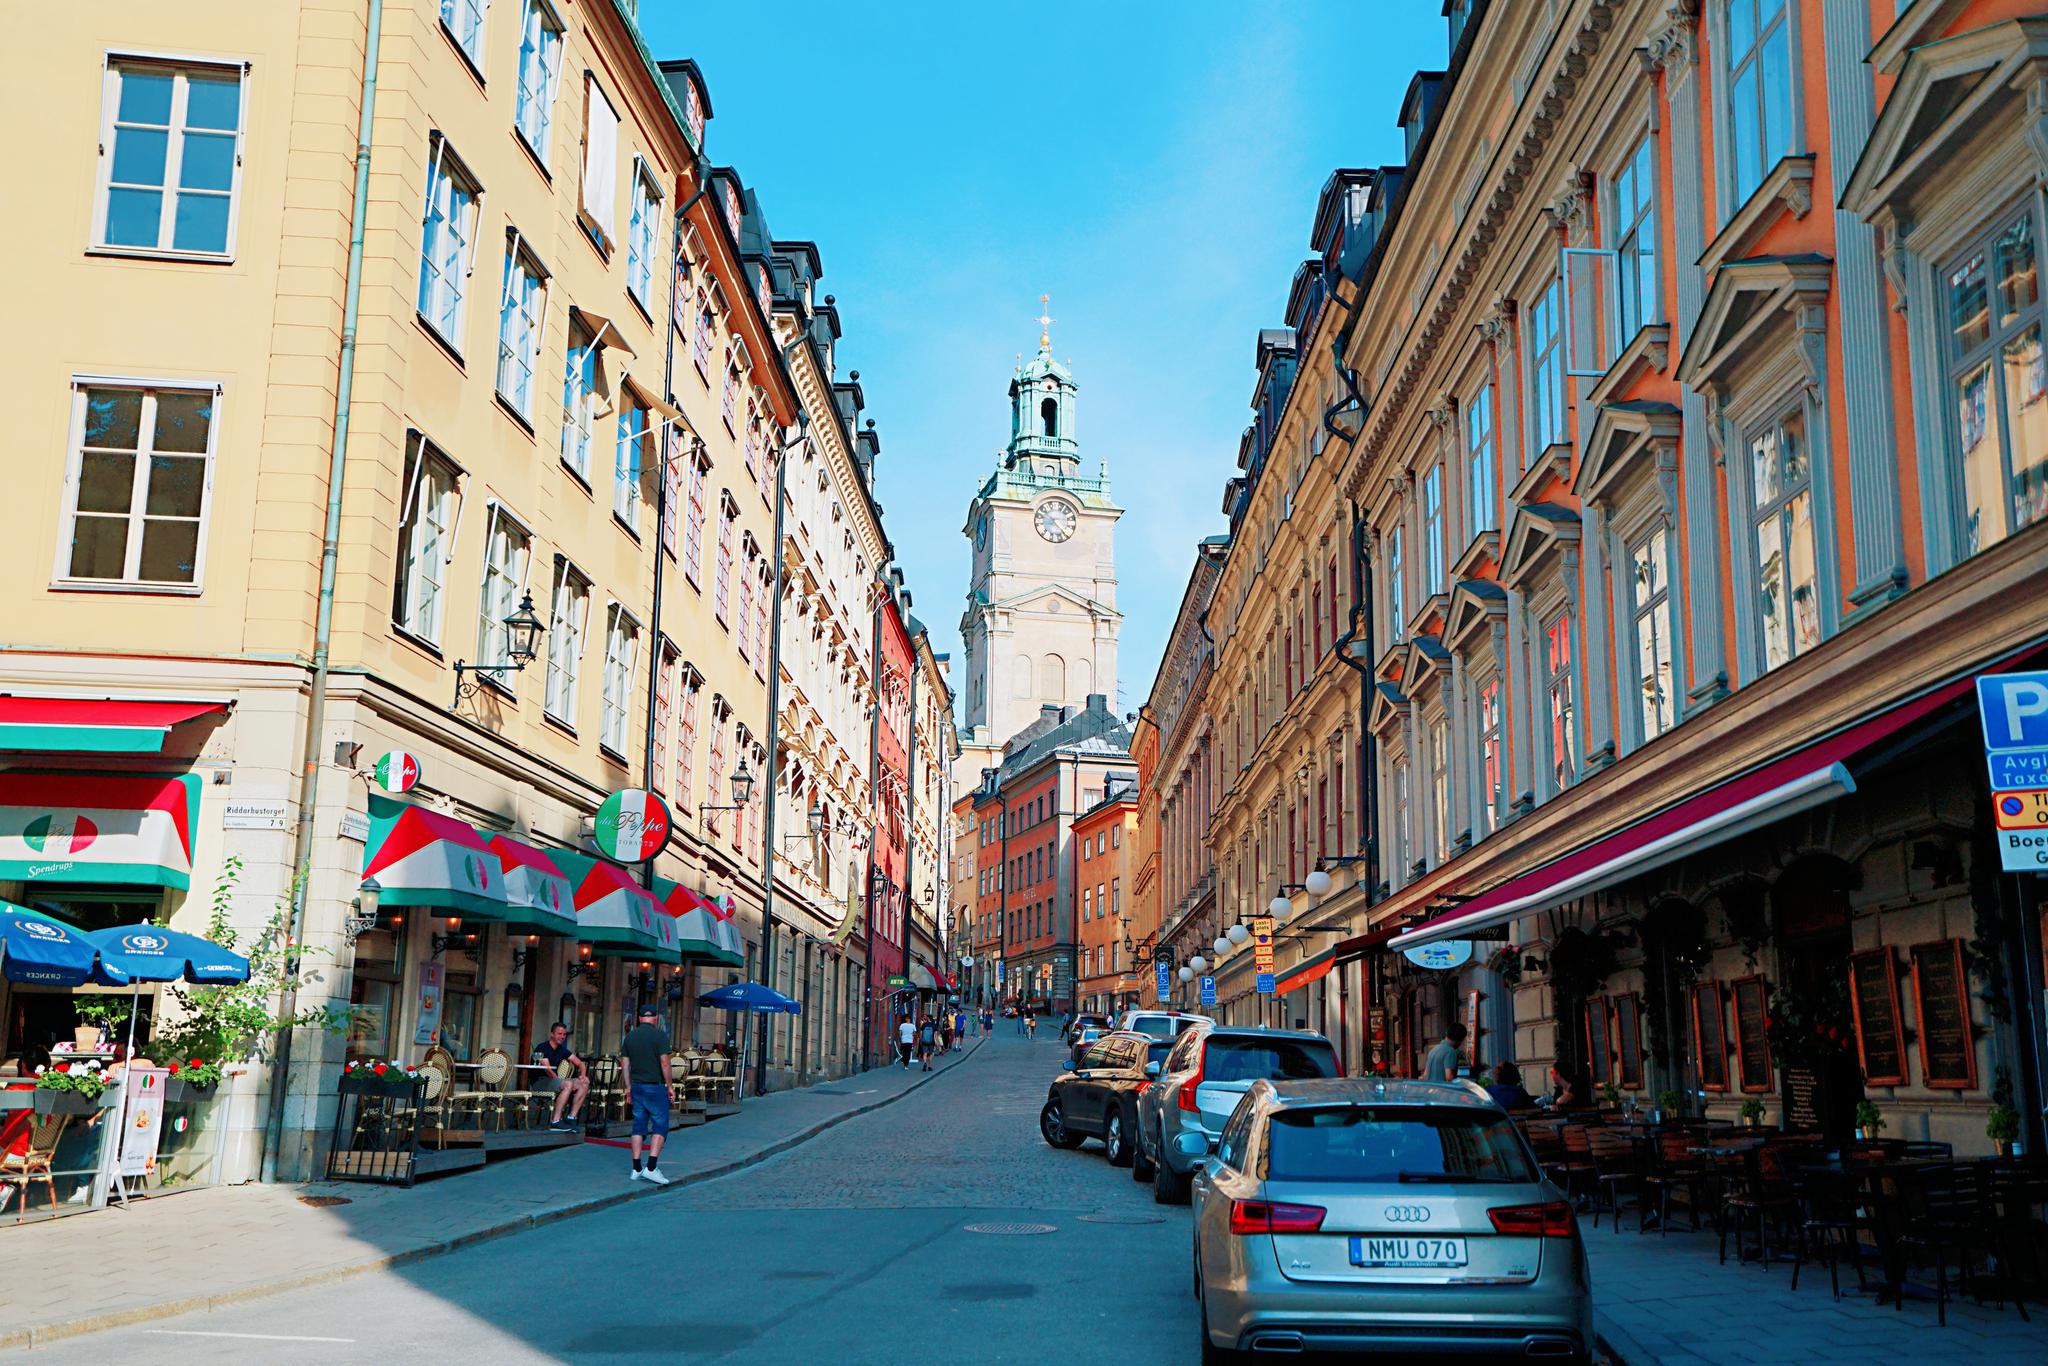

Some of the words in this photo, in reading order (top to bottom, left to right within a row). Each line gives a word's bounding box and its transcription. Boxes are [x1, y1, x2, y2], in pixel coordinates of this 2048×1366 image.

[2002, 680, 2048, 741] P
[226, 806, 285, 816] Riddarhustorget
[270, 819, 275, 827] 7
[279, 819, 284, 827] 9
[611, 810, 664, 838] Peppe
[2009, 834, 2048, 849] Boe
[28, 861, 73, 879] Spendrups
[1159, 963, 1166, 973] P
[1204, 978, 1213, 990] P
[1368, 1240, 1409, 1260] NMU
[1416, 1240, 1458, 1260] 070
